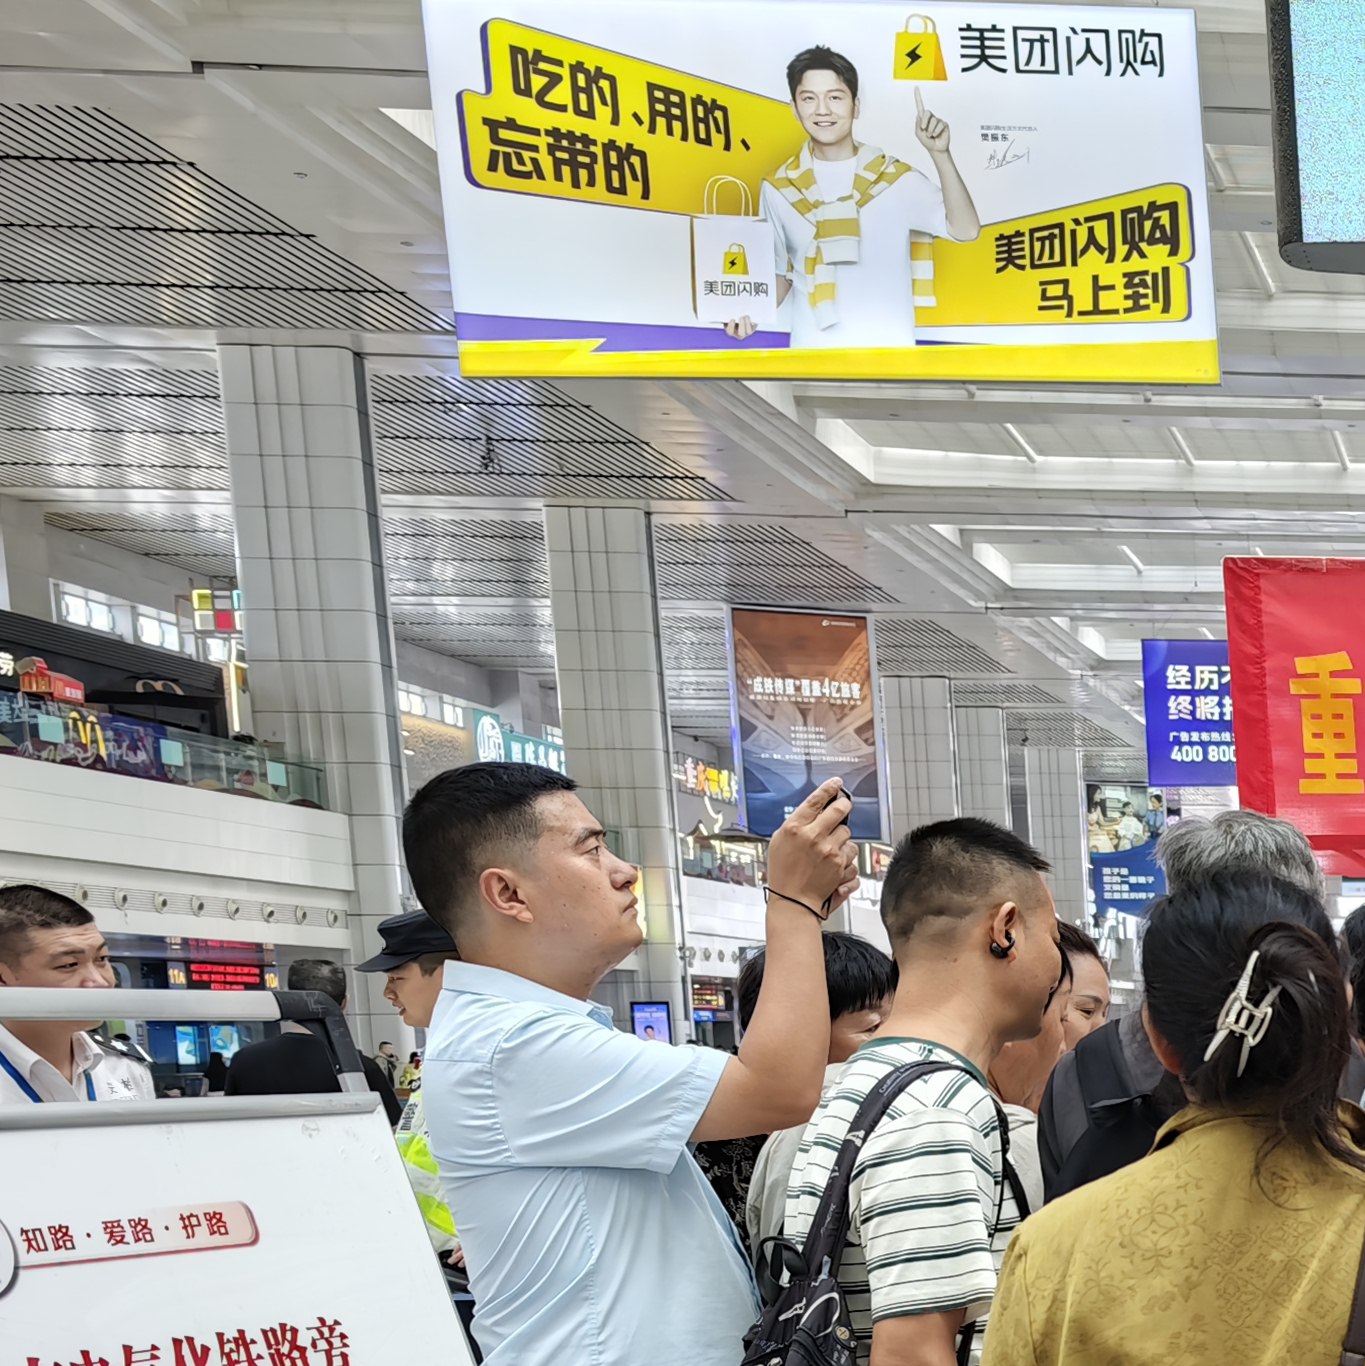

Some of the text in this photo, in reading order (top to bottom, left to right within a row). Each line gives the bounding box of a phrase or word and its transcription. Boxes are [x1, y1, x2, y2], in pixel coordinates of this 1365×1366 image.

[958, 23, 1165, 79] 美团闪购
[509, 44, 752, 153] 吃的、用的、
[482, 116, 652, 200] 忘带的
[994, 200, 1182, 274] 美团闪购
[704, 280, 769, 297] 美团闪购
[1036, 271, 1172, 320] 马上到
[1170, 745, 1203, 762] 400
[168, 968, 187, 985] 11A
